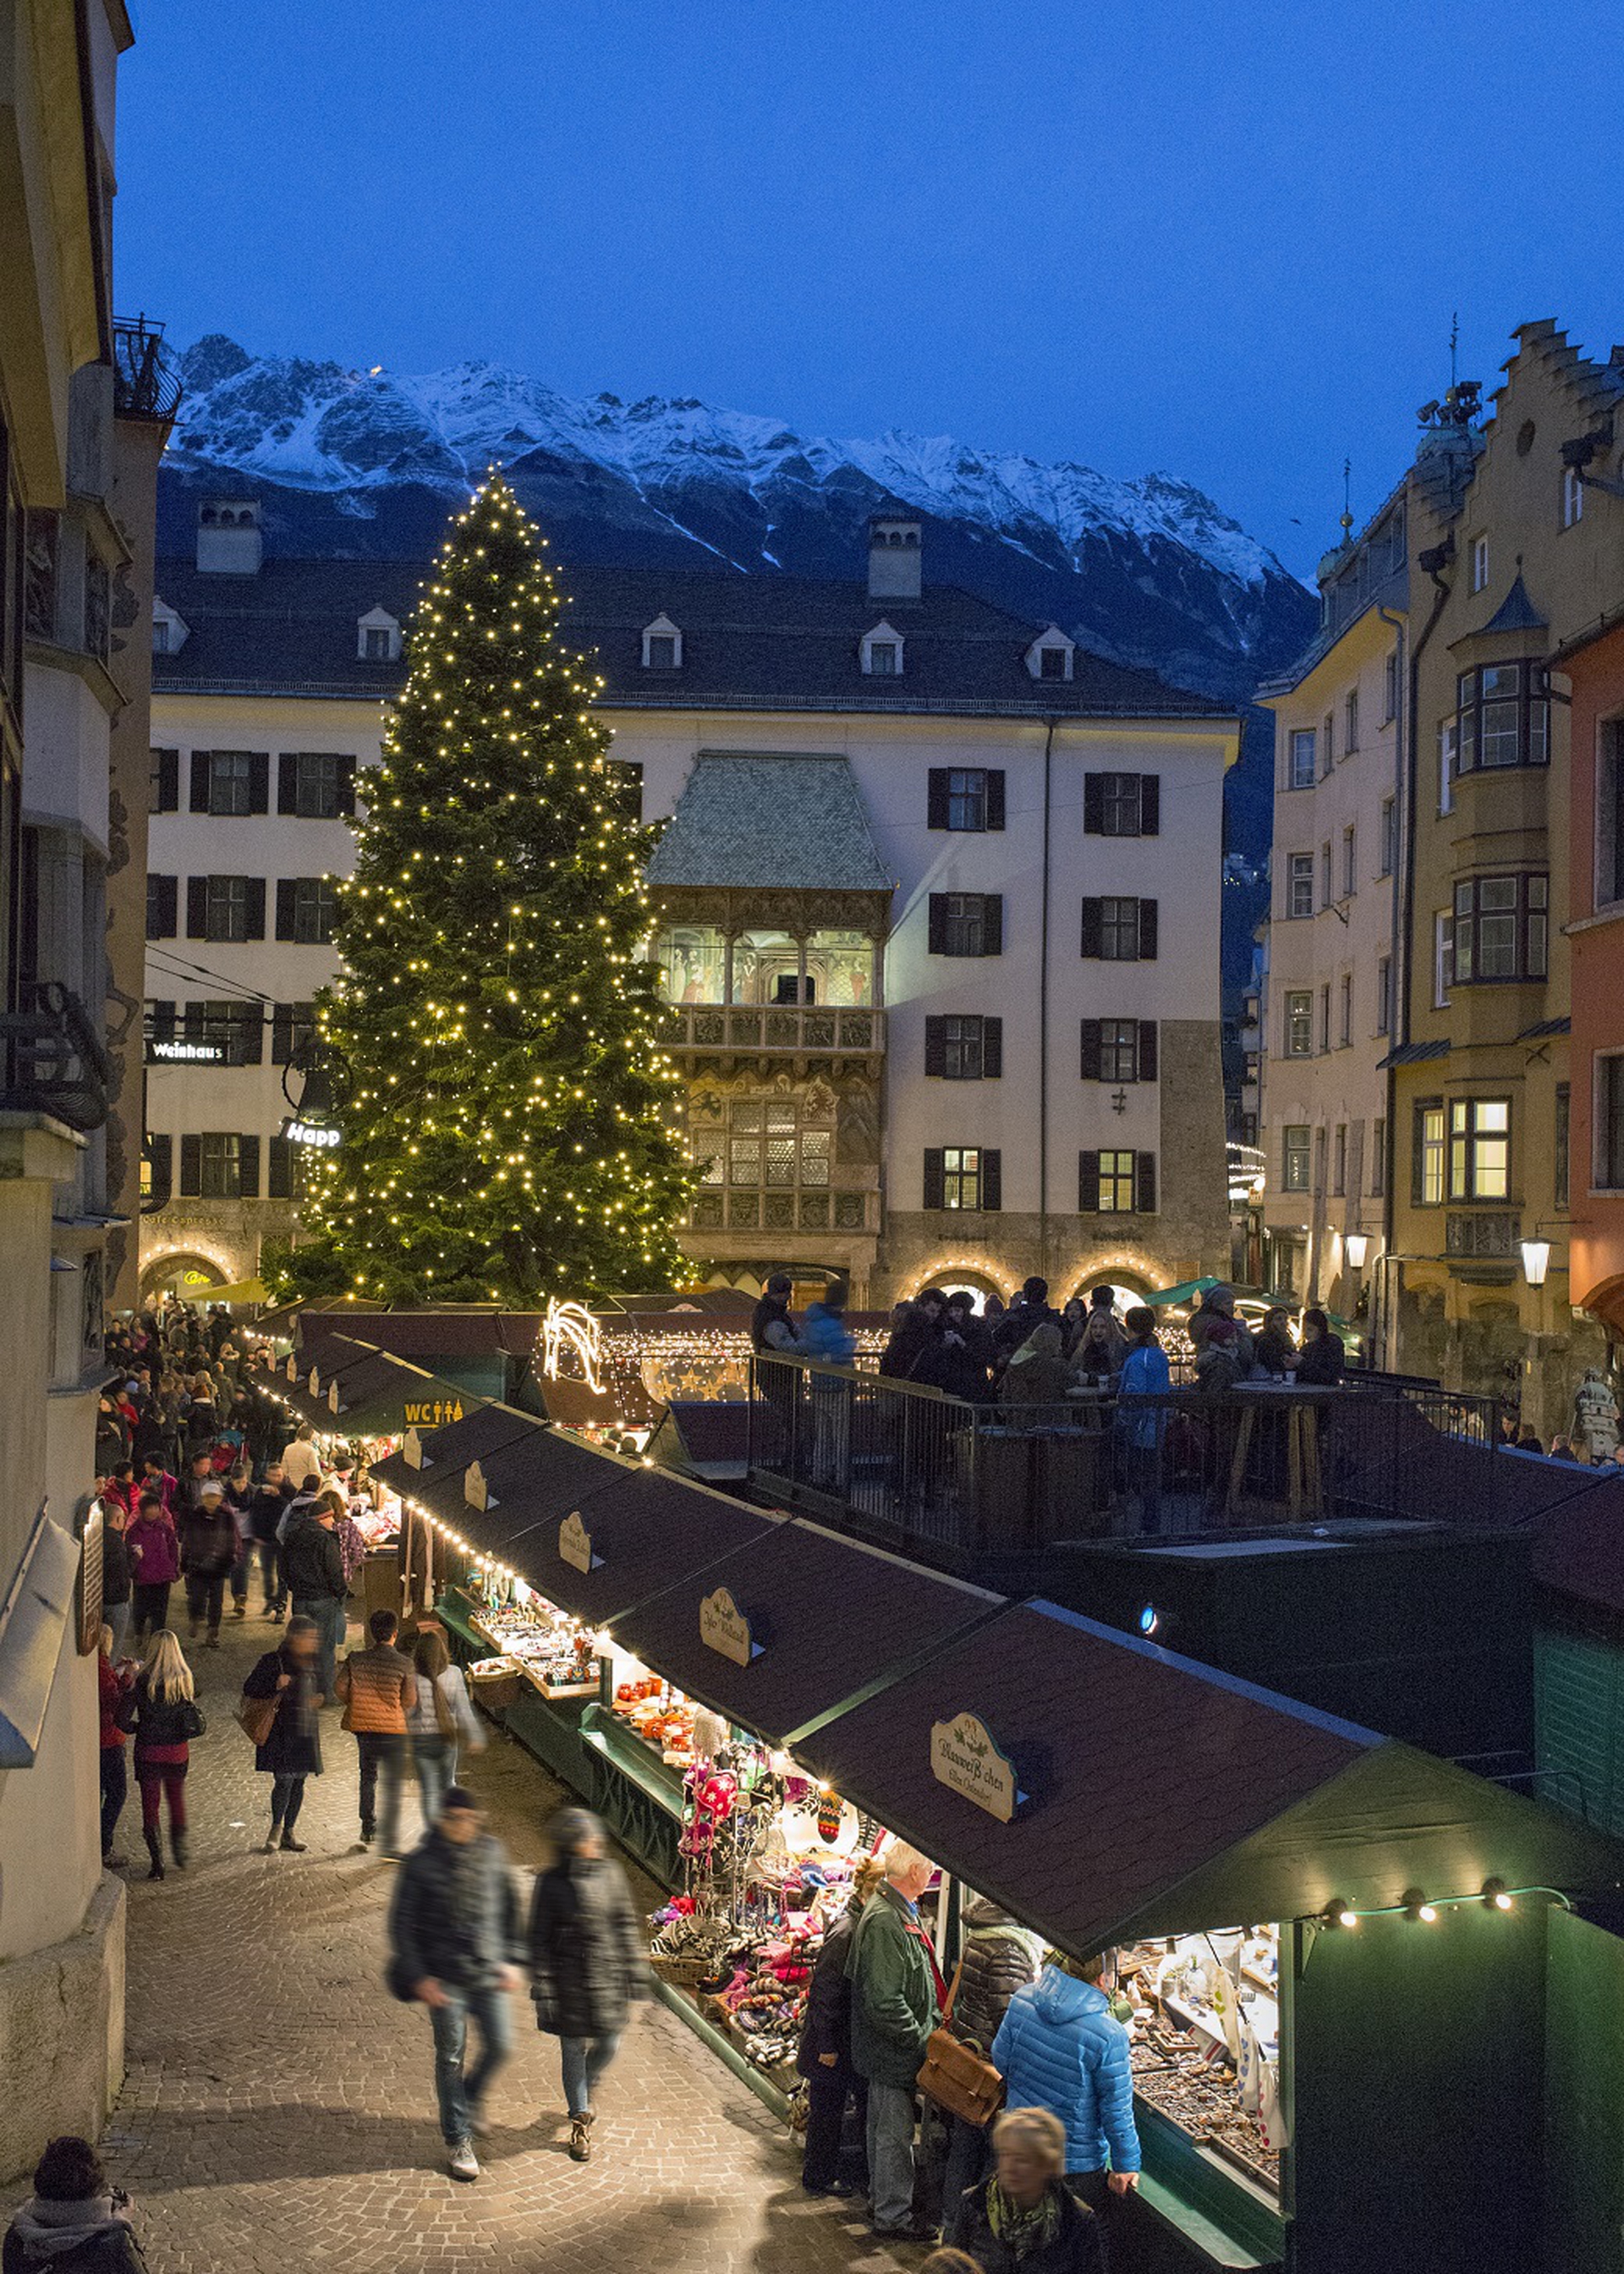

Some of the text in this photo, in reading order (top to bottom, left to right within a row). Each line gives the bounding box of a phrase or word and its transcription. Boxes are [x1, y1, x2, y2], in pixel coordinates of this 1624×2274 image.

[152, 1041, 222, 1058] Weinhaus
[287, 1122, 340, 1147] Happ
[404, 1403, 431, 1422] WC
